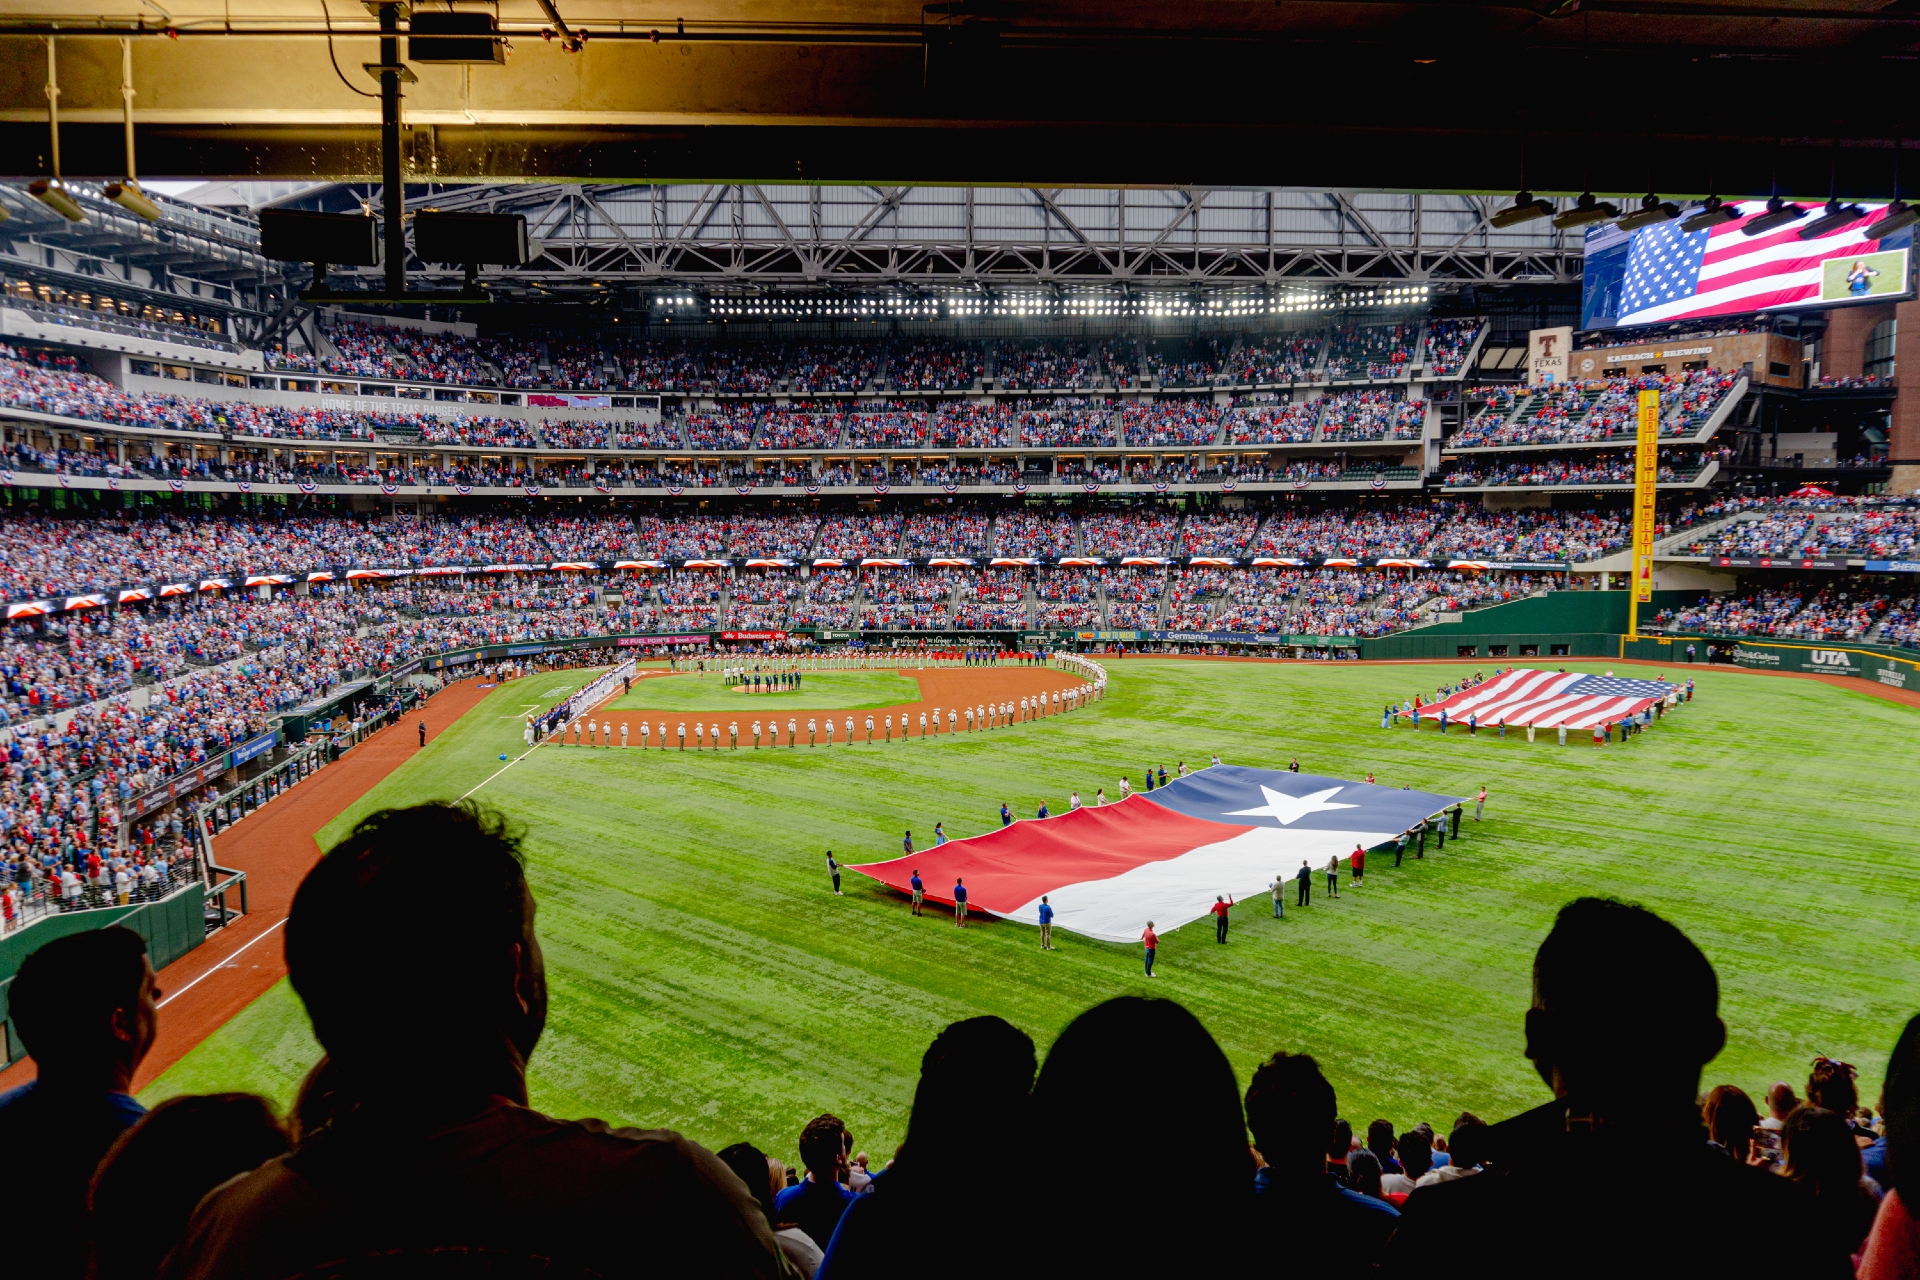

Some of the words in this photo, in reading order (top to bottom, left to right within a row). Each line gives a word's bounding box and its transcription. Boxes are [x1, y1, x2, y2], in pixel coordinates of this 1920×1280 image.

[1539, 335, 1557, 357] T
[1607, 352, 1655, 363] KARBACH
[1662, 346, 1713, 358] BREWING
[1534, 359, 1562, 368] TEXAS
[321, 399, 352, 411] HOME
[355, 400, 368, 412] OF
[370, 401, 388, 413] THE
[391, 403, 421, 415] TEXAS
[423, 405, 465, 417] RANGERS
[1167, 632, 1208, 640] Germania
[1811, 650, 1851, 666] UTA
[1876, 668, 1906, 681] ESTRELLA
[1879, 675, 1903, 688] JALISCO
